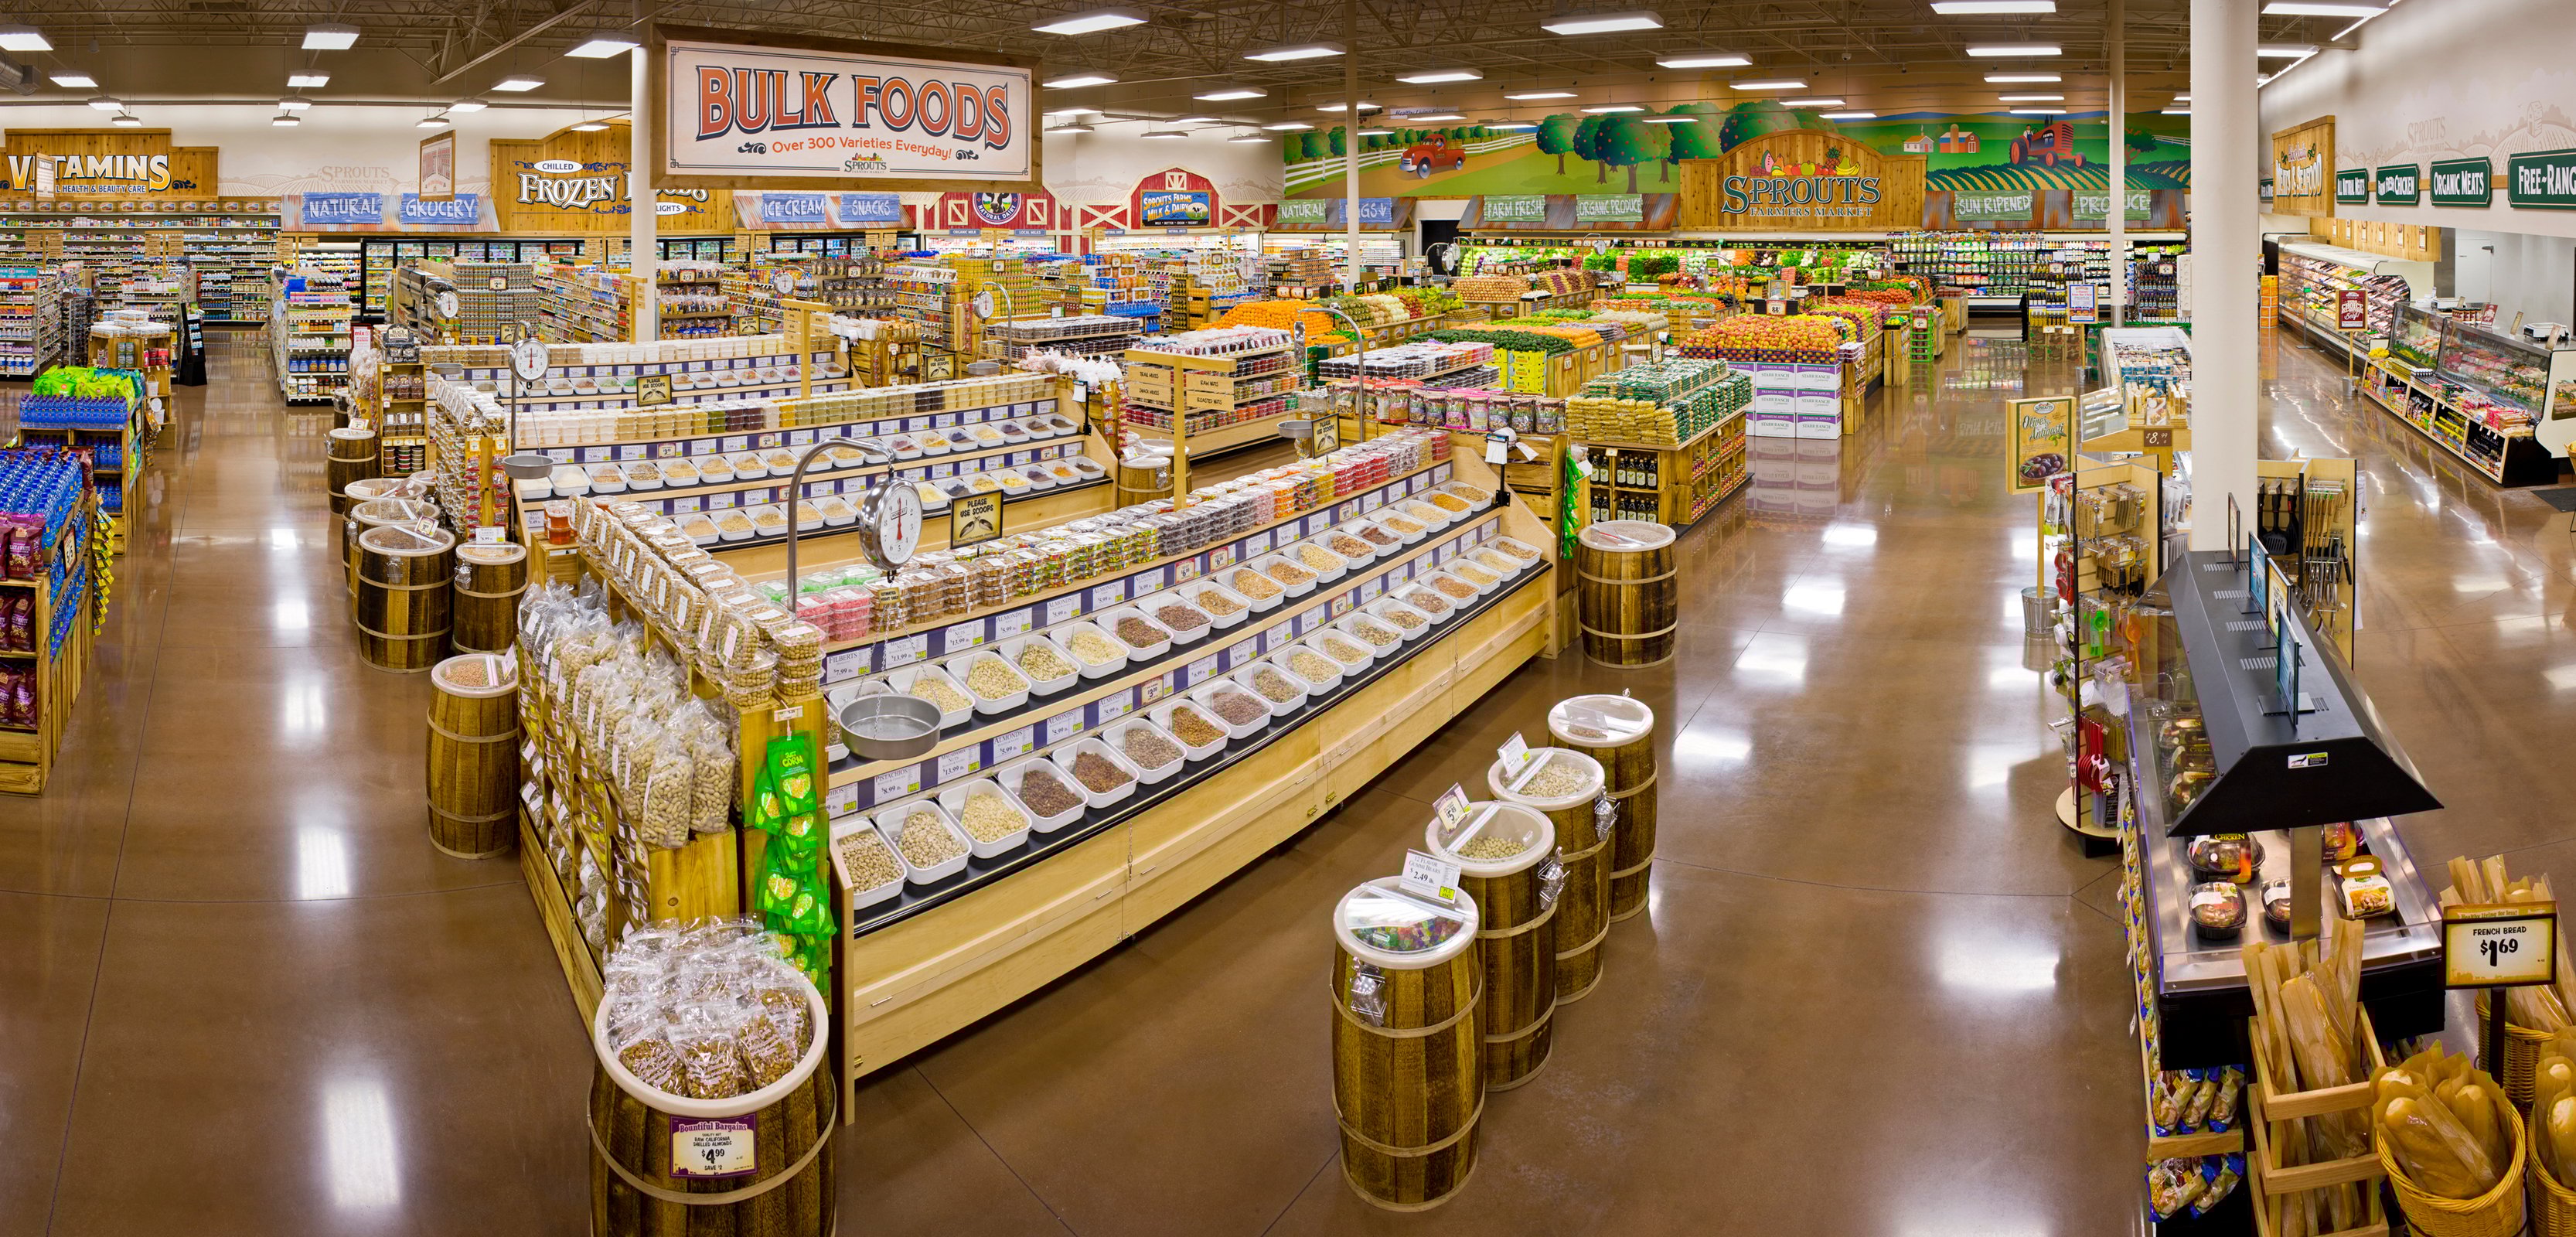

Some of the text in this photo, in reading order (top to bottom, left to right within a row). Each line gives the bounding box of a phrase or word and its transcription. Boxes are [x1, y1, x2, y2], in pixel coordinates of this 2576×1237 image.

[695, 64, 1011, 150] BULK FOODS
[2407, 116, 2446, 152] SPROUTS
[772, 136, 952, 162] Over 300 Varieties Everyday!
[542, 162, 574, 171] CHILLED
[844, 160, 887, 172] SPROUTS
[8, 155, 172, 192] VTAMINS
[322, 165, 390, 182] SPROUTS
[2276, 159, 2291, 197] MEATS
[2297, 152, 2322, 198] SEAFOOD
[90, 184, 96, 193] &
[98, 184, 125, 193] BEAUTY
[128, 184, 145, 193] CARE
[516, 170, 618, 209] FROZEN
[2395, 175, 2414, 195] CHICKEN
[2434, 170, 2485, 196] ORGANIC MEATS
[1720, 175, 1881, 213] SPROUTS
[309, 198, 379, 218] NATURAL
[406, 198, 475, 219] GROCERY
[764, 198, 824, 216] ICE CREAM
[852, 199, 891, 216] SNACKS
[1143, 193, 1192, 211] SPROUTS FARMS
[1579, 199, 1642, 217] ORGANIC PRODUCE
[1959, 195, 2033, 216] SUN RIPENED
[2080, 195, 2148, 213] PROUCE
[977, 204, 1016, 220] NATURAL DAIRY
[1147, 203, 1189, 221] MILK & DAIRY
[1280, 201, 1325, 218] NATURAL
[1487, 202, 1545, 219] FARM FRESH
[1750, 207, 1872, 216] FARMERS MARKET
[2022, 415, 2046, 430] Olives
[2029, 422, 2064, 442] Antipasti
[2146, 431, 2168, 445] $8.99
[967, 498, 988, 509] PLEASE
[960, 504, 994, 518] USE SCOOPS
[1093, 583, 1116, 595] ALMONDS
[1048, 597, 1072, 609] ALMONDS
[996, 612, 1022, 622] ALMONDS
[946, 624, 973, 633] MACADAMIA
[949, 637, 965, 646] $13.99
[1229, 641, 1249, 653] WALNUTS
[829, 652, 857, 664] FILBERTS
[891, 653, 908, 662] $13.99
[1099, 693, 1124, 705] ALMONDS
[1047, 711, 1074, 724] ALMONDS
[994, 730, 1023, 744] ALMONDS
[1051, 727, 1064, 736] $5.99
[940, 748, 966, 760] MACADAMIA
[999, 745, 1013, 755] $5.99
[782, 756, 804, 768] CORN
[875, 768, 908, 782] PISTACHIOS
[943, 765, 959, 776] $13.99
[881, 785, 895, 795] $8.99
[1421, 857, 1438, 867] FLAVOR
[1426, 864, 1441, 874] BEARS
[2503, 926, 2527, 935] BREAD
[679, 1122, 748, 1133] Bountiful Bargains
